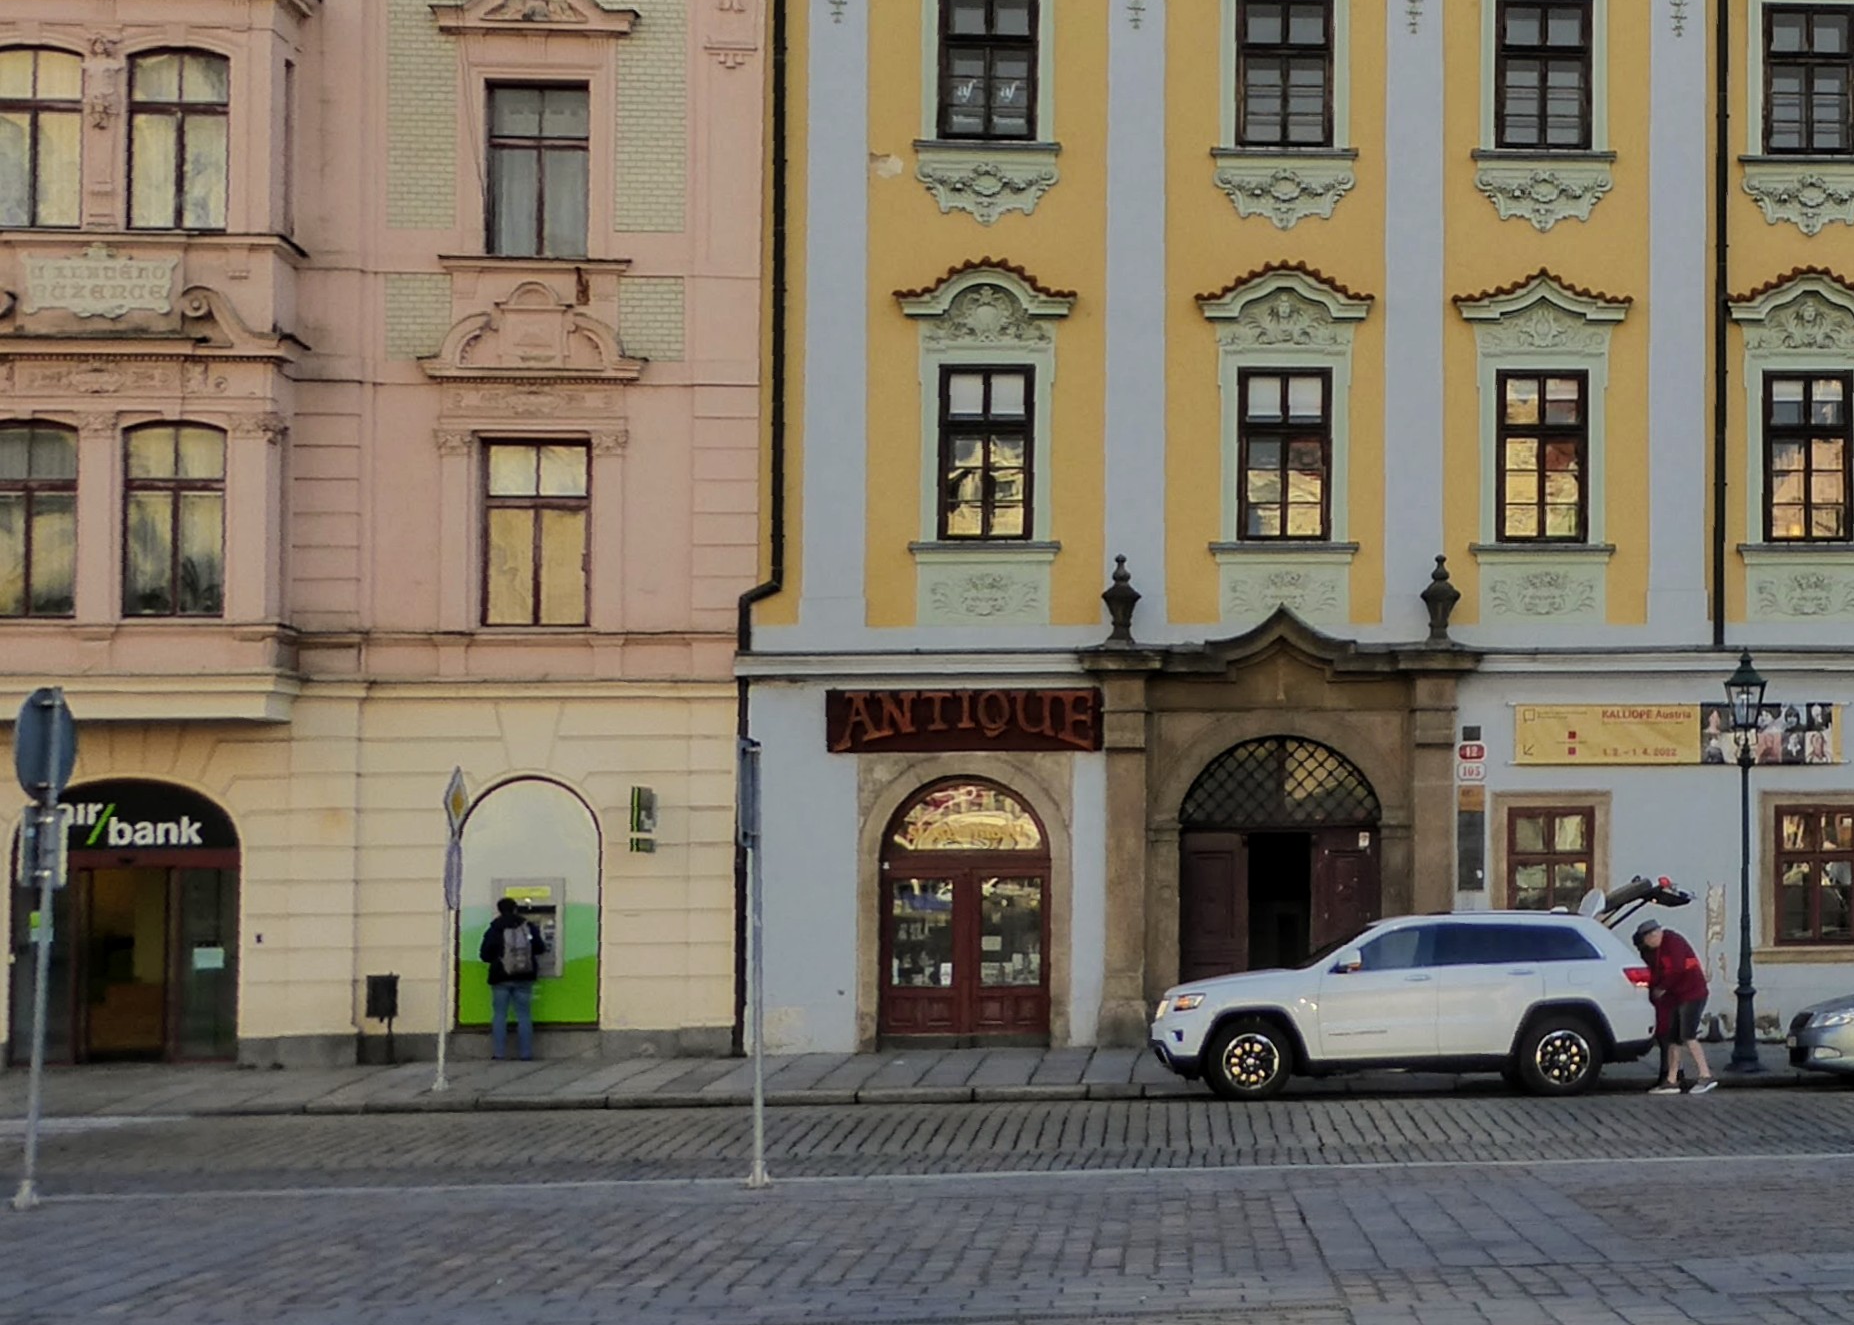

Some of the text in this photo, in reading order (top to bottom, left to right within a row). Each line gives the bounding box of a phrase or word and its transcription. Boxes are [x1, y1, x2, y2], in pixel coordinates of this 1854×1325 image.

[831, 690, 1093, 752] ANTIQUE
[1602, 710, 1691, 719] KALLIOPE Austria
[108, 816, 202, 846] bank
